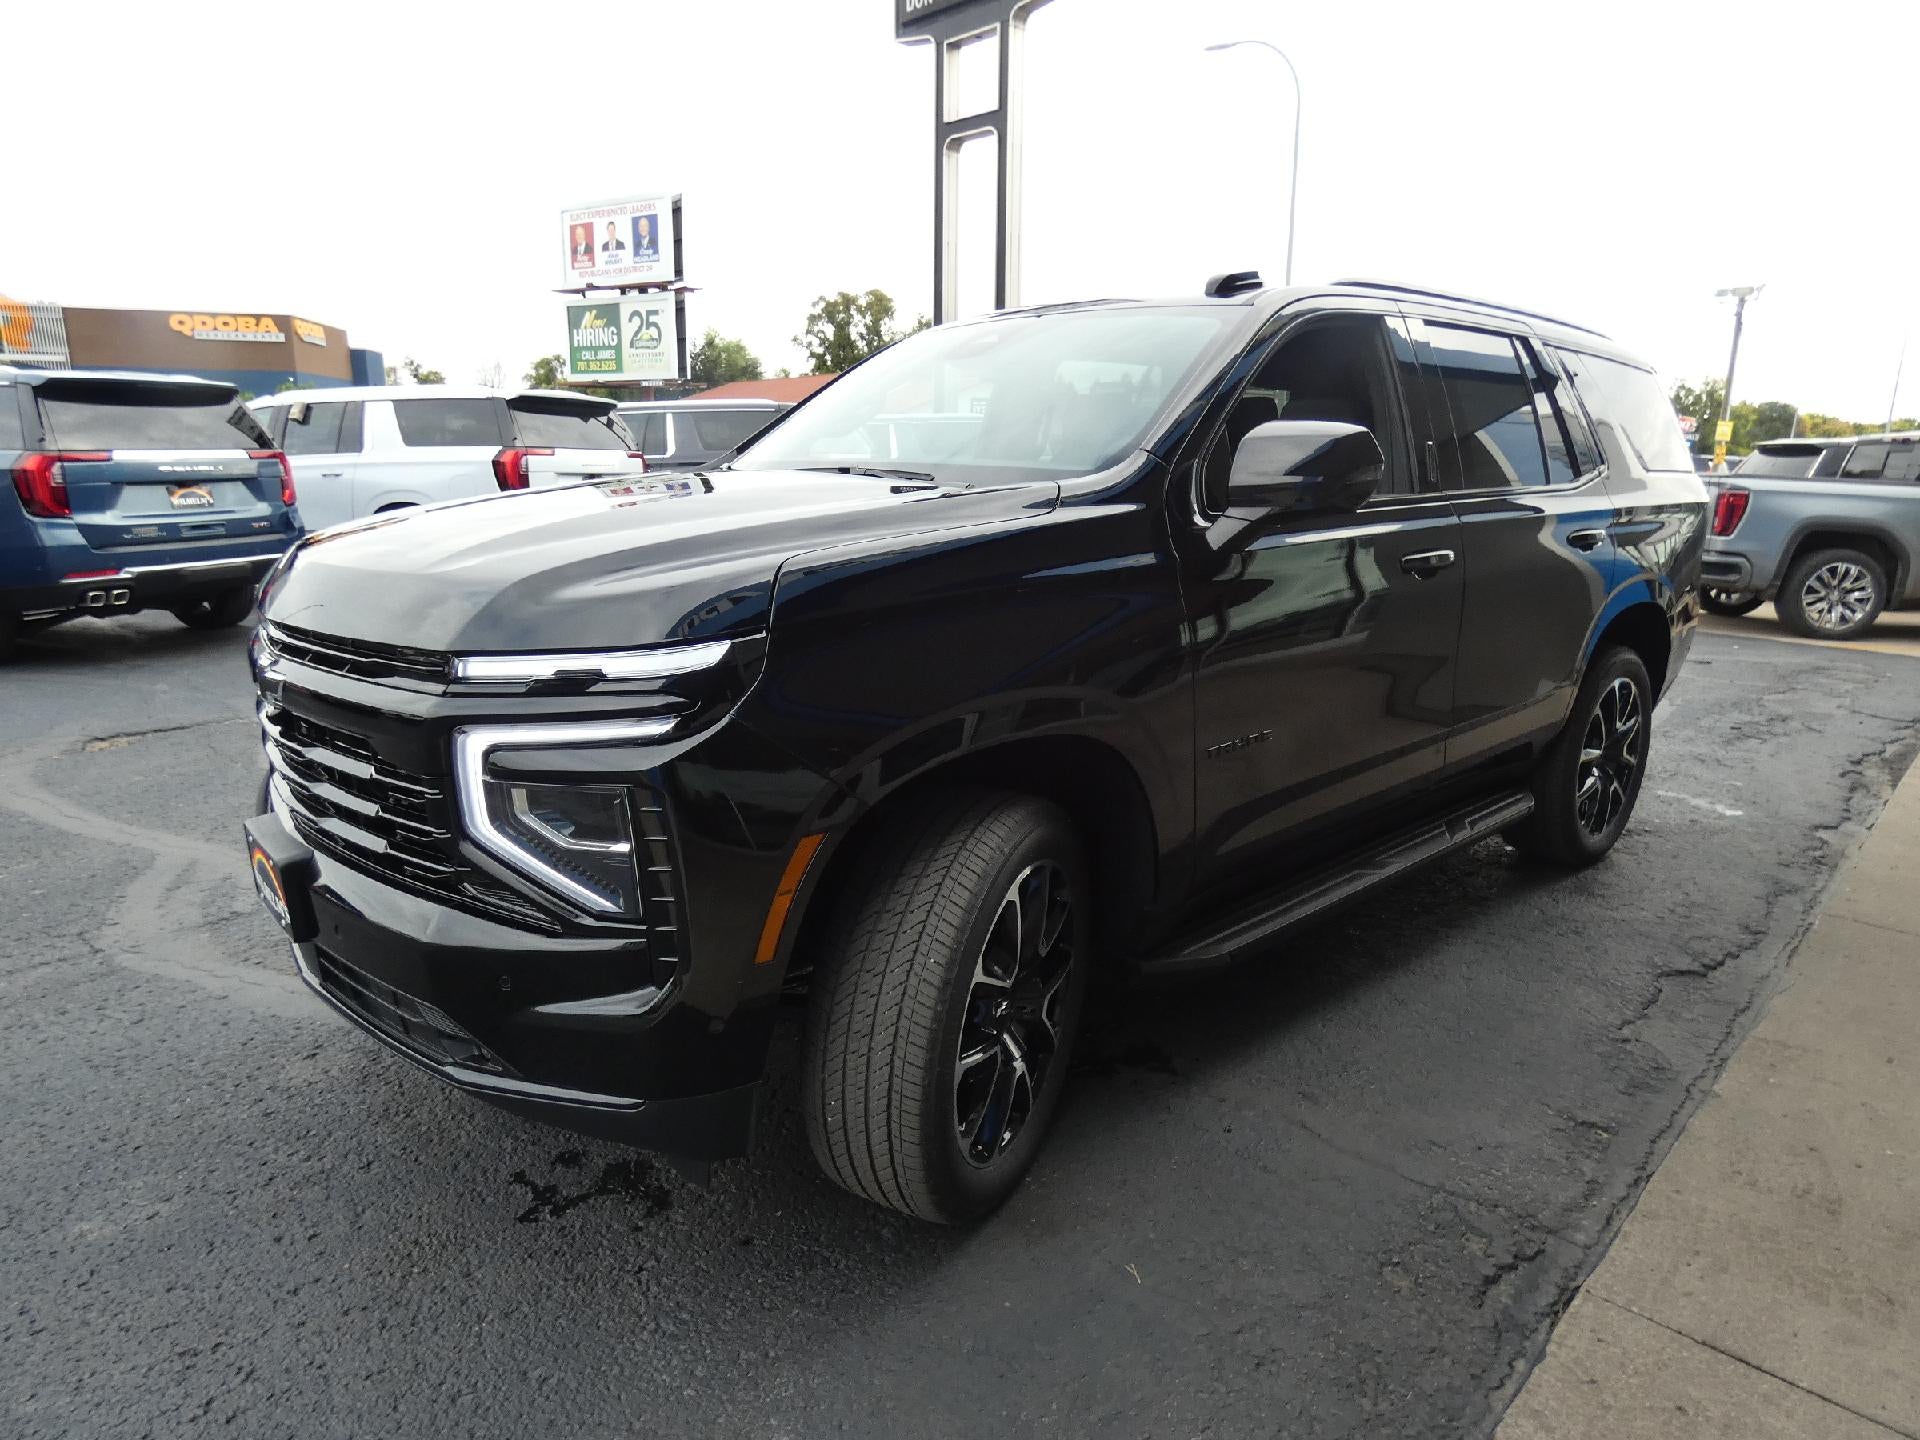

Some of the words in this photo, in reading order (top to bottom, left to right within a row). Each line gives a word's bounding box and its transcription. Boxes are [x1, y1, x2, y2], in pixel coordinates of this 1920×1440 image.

[630, 202, 657, 214] LEADERS
[169, 314, 279, 336] QDOBA
[628, 309, 662, 349] 25
[573, 326, 618, 347] HIRING
[581, 350, 597, 360] CALL
[597, 349, 616, 359] JAMES
